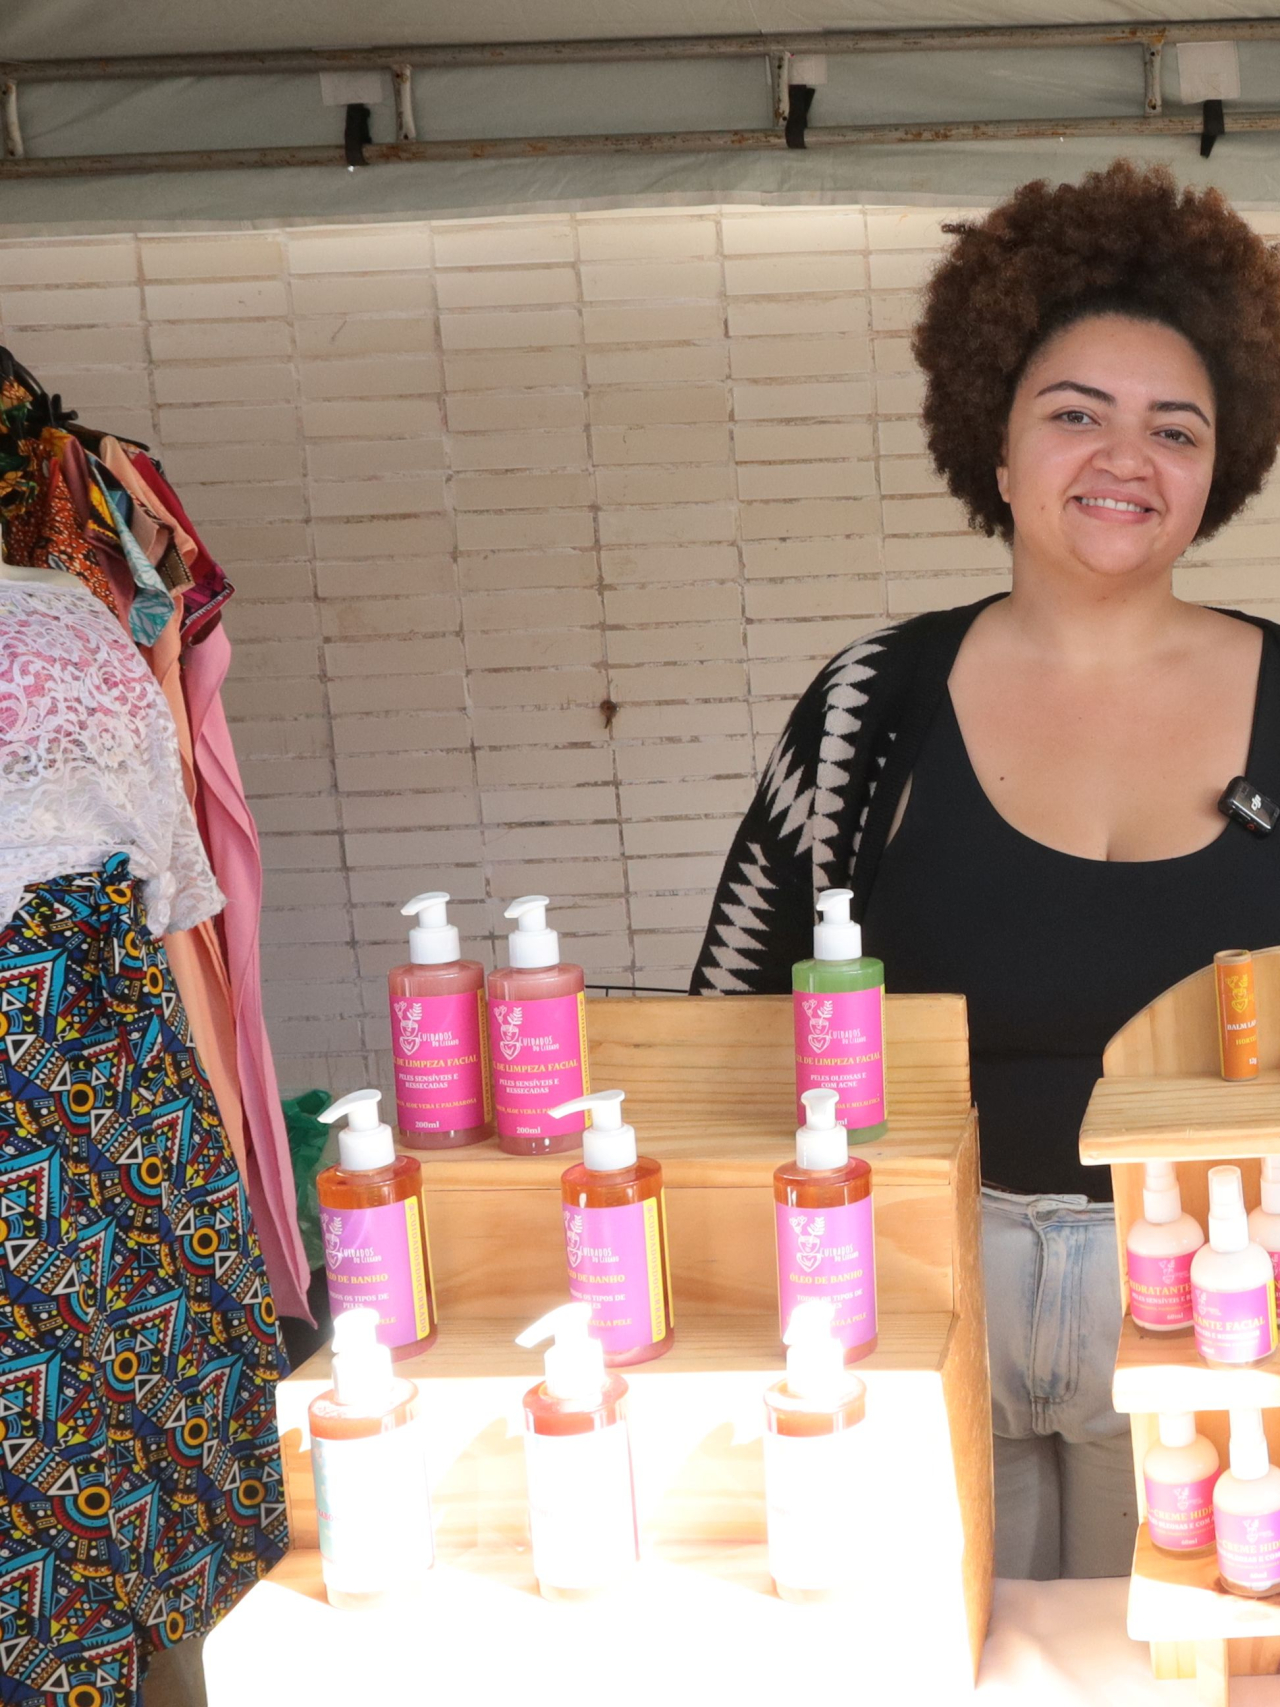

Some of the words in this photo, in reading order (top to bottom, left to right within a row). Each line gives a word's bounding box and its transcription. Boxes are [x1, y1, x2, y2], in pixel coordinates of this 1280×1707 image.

[1227, 1023, 1247, 1031] BALM
[405, 1057, 445, 1068] LIMPEZA
[447, 1054, 478, 1067] FACIAL
[805, 1056, 814, 1065] DE
[814, 1056, 854, 1066] LIMPEZA
[856, 1051, 881, 1064] FACIAL
[505, 1063, 546, 1073] LIMPEZA
[548, 1059, 578, 1072] FACIAL
[415, 1072, 453, 1082] SENSÍVEIS
[810, 1074, 830, 1082] PELES
[830, 1073, 861, 1082] OLEOSAS
[405, 1081, 448, 1089] RESSECADAS
[516, 1078, 553, 1087] SENSÍVEIS
[838, 1080, 858, 1088] ACNE
[506, 1086, 549, 1094] RESSECADAS
[415, 1121, 440, 1129] 200ml
[516, 1126, 541, 1135] 200ml
[408, 1202, 427, 1333] @CUIDADOSDOCERRADO
[646, 1204, 663, 1336] @CUIDADOSDOCERRADO
[338, 1275, 350, 1284] DE
[351, 1273, 389, 1284] BANHO
[578, 1273, 588, 1282] DE
[589, 1273, 625, 1284] BANHO
[789, 1272, 812, 1284] ÓLEO
[814, 1275, 828, 1285] DE
[830, 1269, 864, 1284] BANHO
[377, 1292, 390, 1300] DE
[592, 1294, 613, 1302] TIPOS
[832, 1293, 853, 1302] TIPOS
[854, 1289, 863, 1298] DE
[613, 1318, 632, 1326] PELE
[1225, 1315, 1265, 1331] FACIAL
